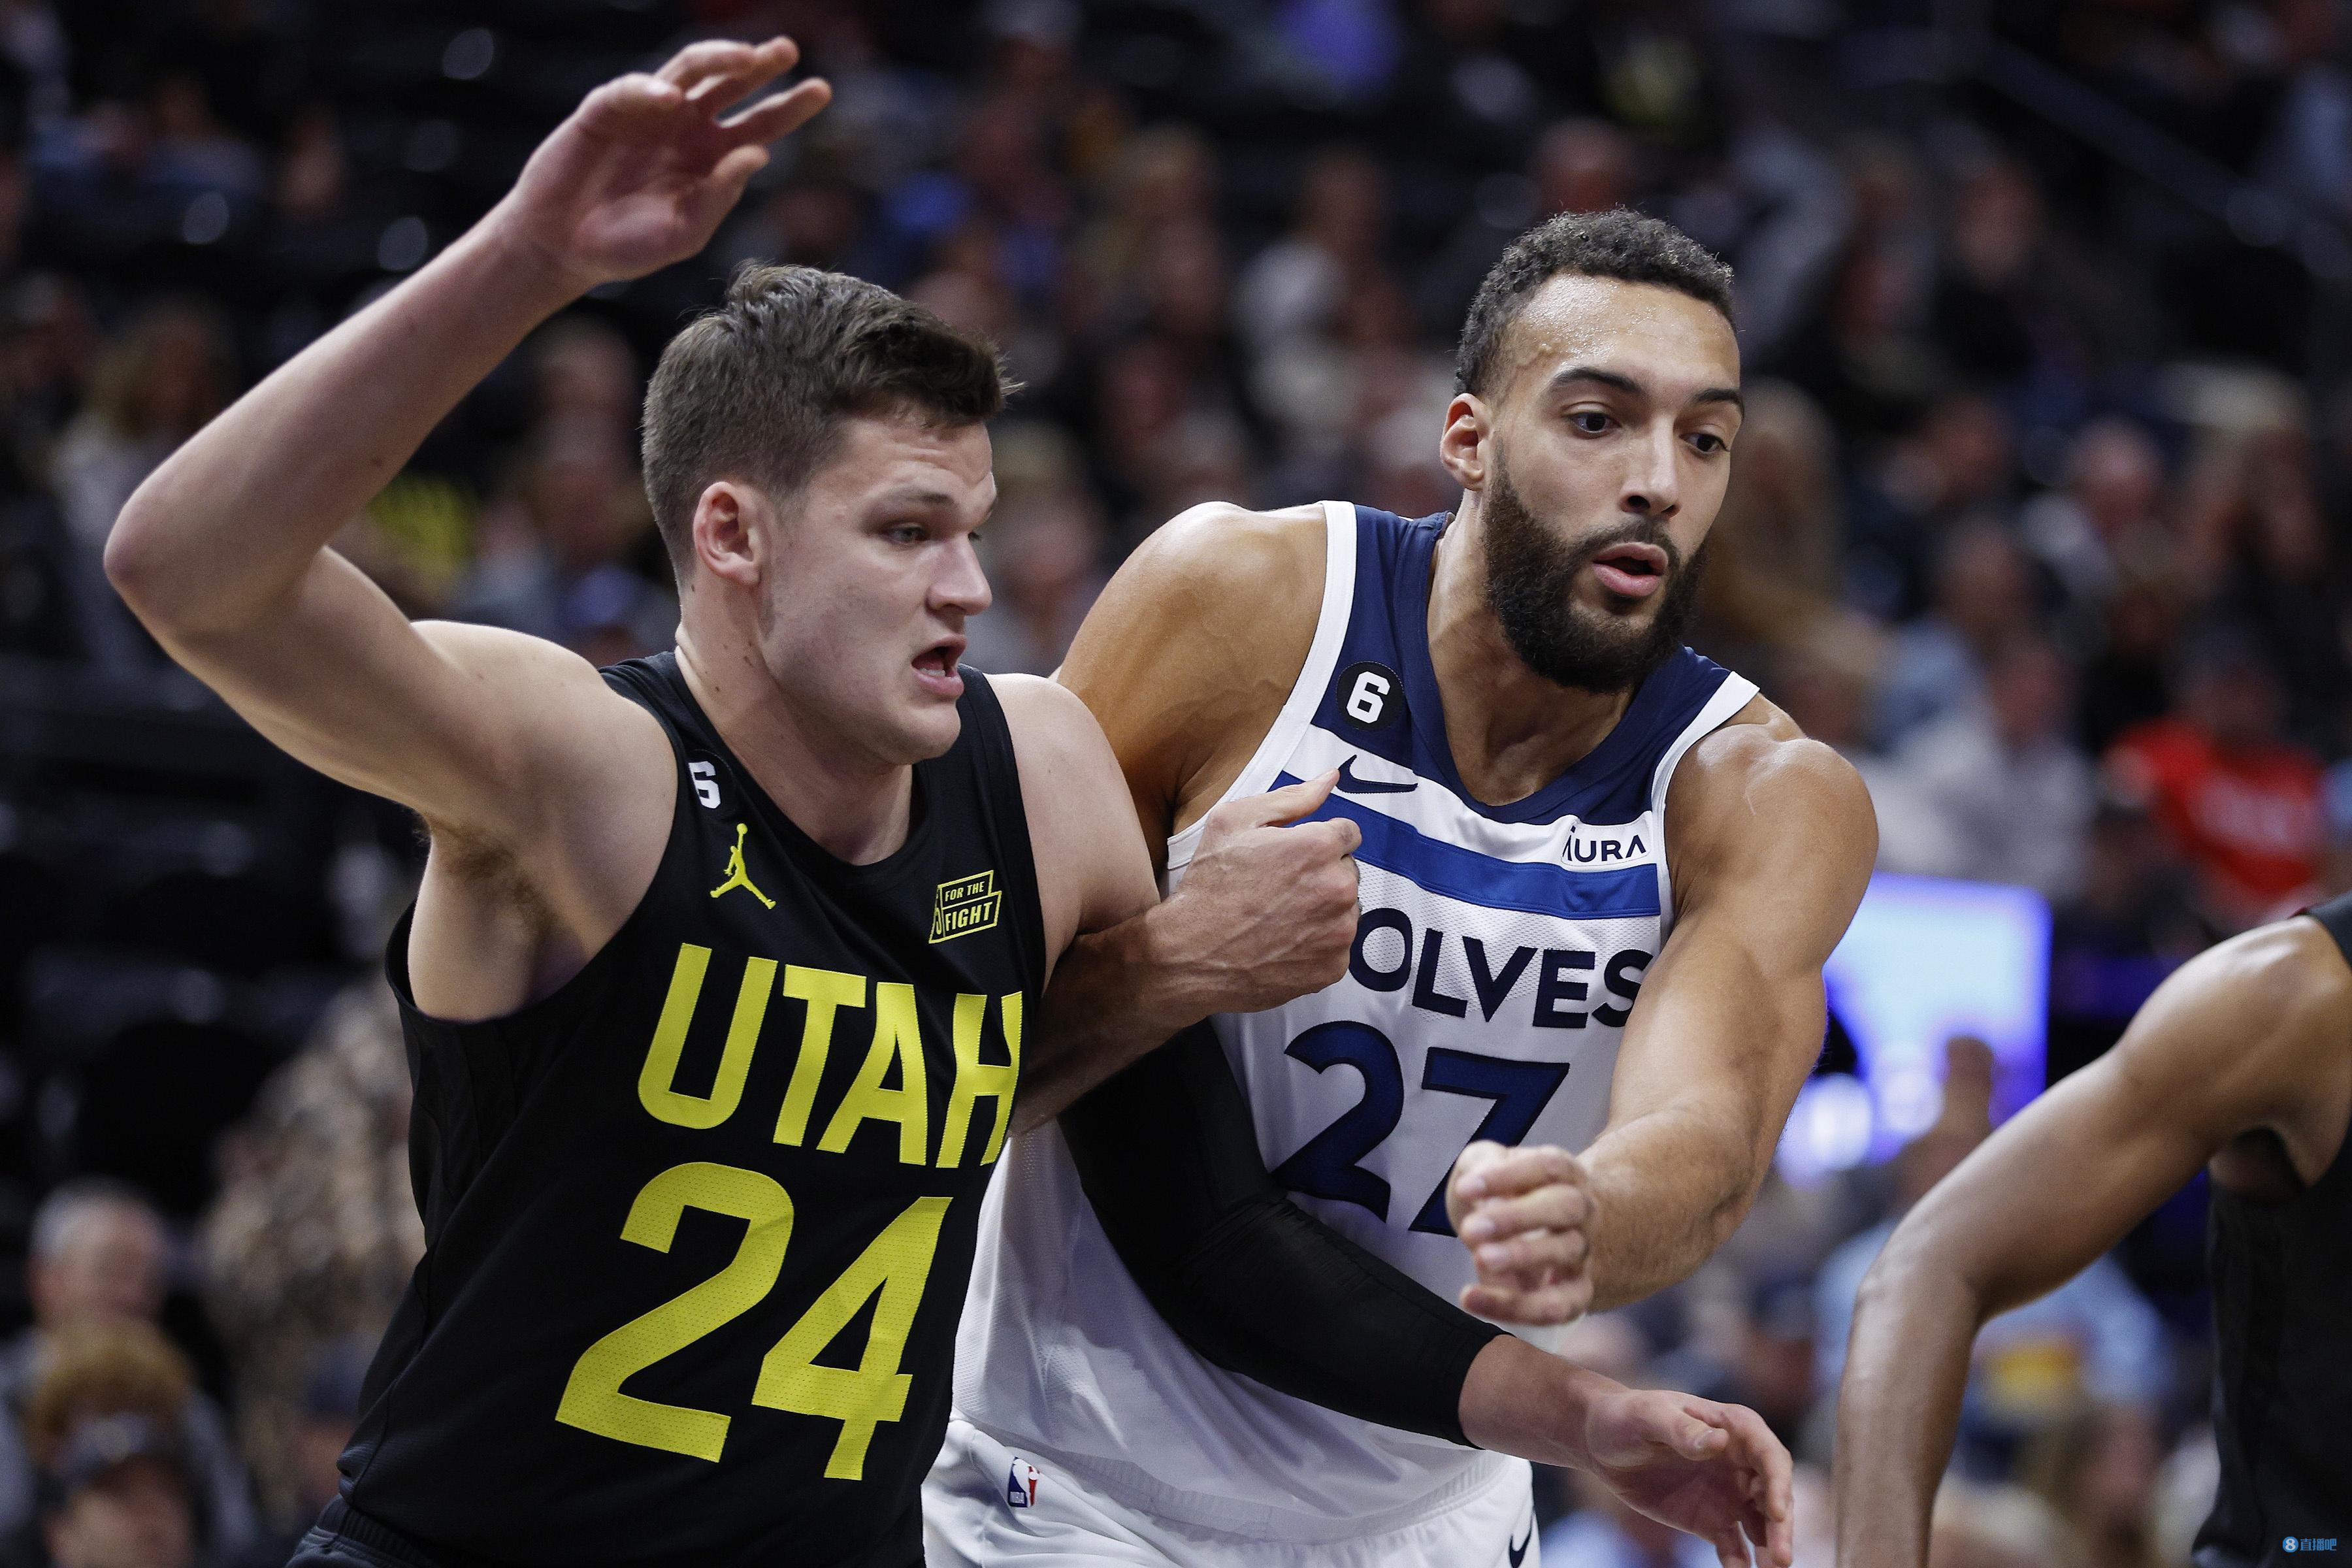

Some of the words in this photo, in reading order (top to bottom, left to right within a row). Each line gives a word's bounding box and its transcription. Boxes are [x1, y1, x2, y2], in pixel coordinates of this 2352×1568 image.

[1346, 671, 1391, 724] 6
[688, 760, 721, 809] 6
[945, 887, 964, 902] FOR
[967, 881, 985, 896] THE
[945, 902, 993, 932] FIGHT
[1348, 907, 1653, 1028] OLVES
[638, 943, 1022, 1168] UTAH
[1270, 1020, 1570, 1237] 27
[555, 1161, 953, 1480] 24
